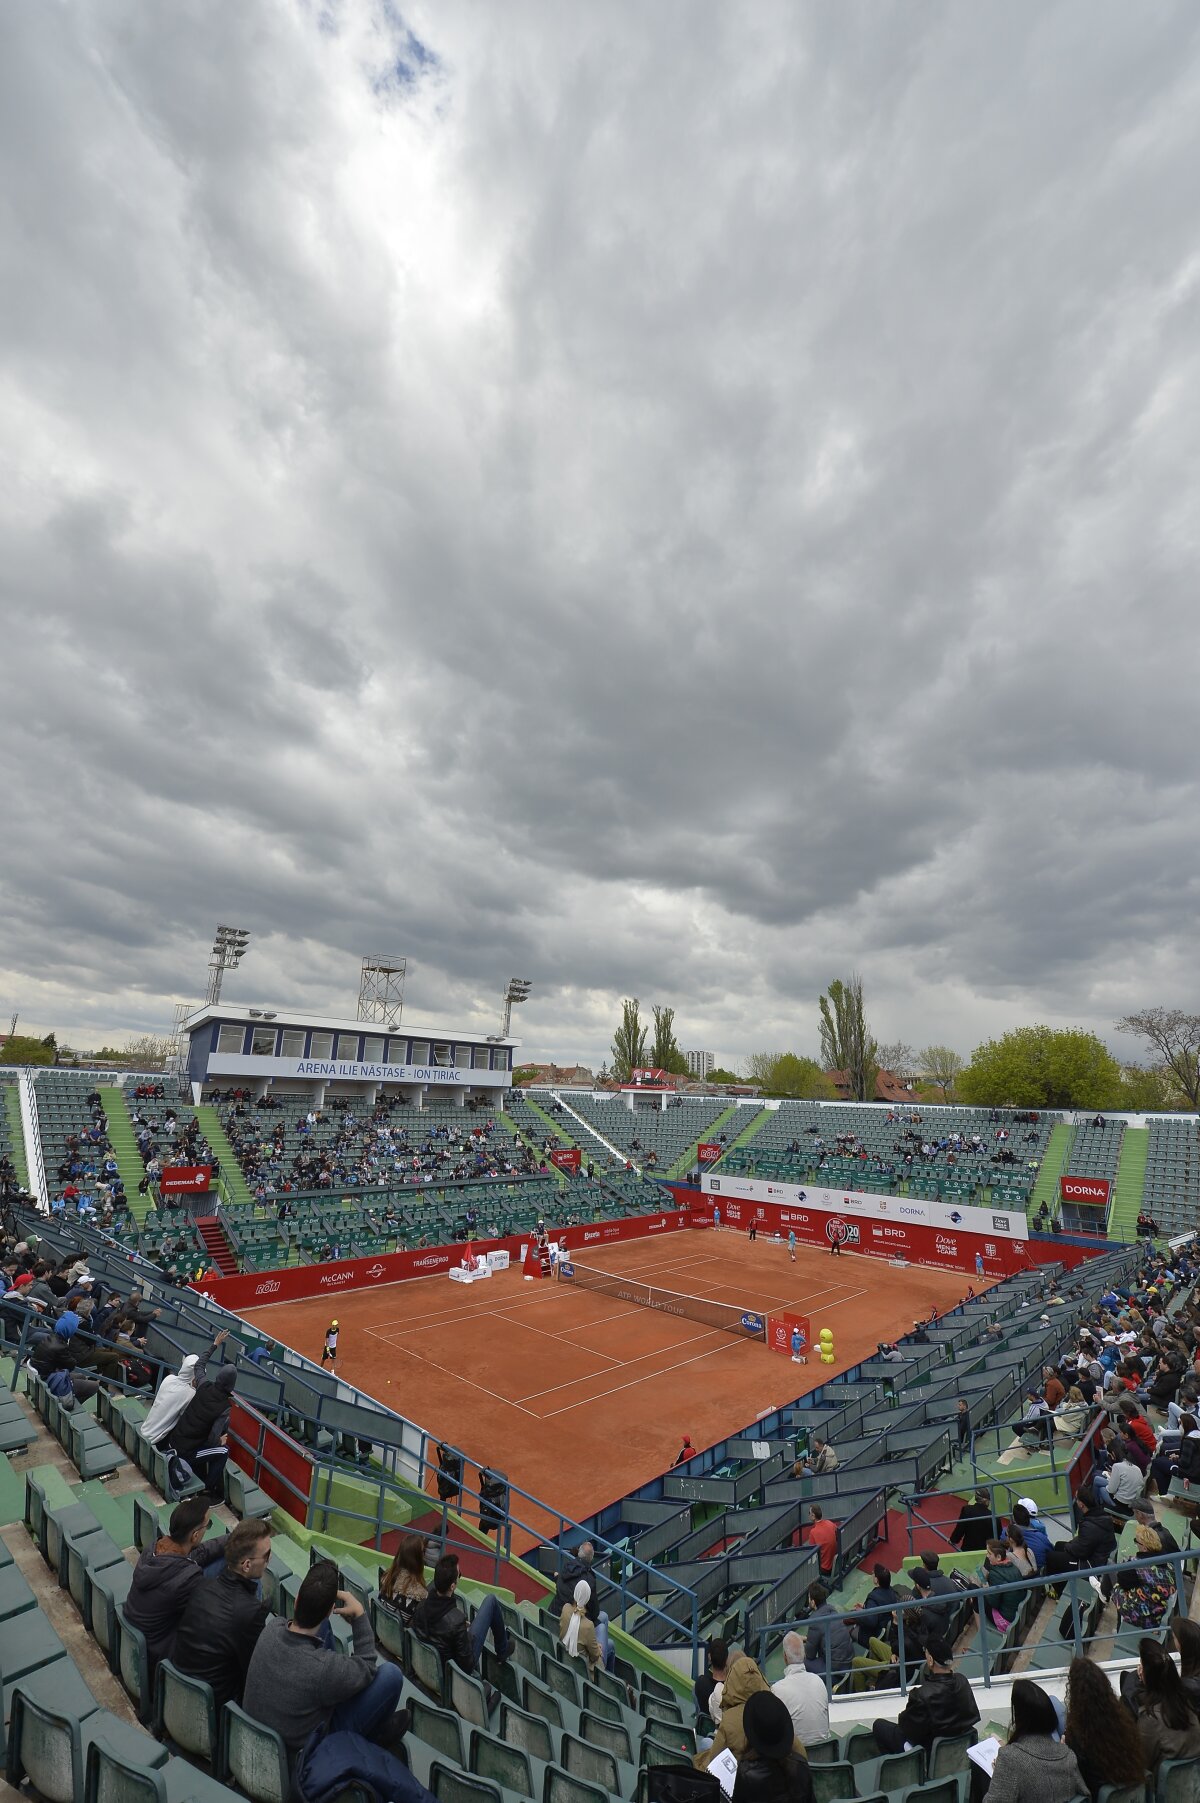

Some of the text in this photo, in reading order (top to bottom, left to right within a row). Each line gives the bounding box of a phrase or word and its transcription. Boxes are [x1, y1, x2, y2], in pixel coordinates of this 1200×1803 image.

[297, 1062, 337, 1075] ARENA
[340, 1065, 358, 1076] ILIE
[361, 1067, 405, 1078] NĂSTASE
[414, 1069, 431, 1079] ION
[1065, 1185, 1106, 1197] DORNA
[790, 1213, 809, 1222] BRD
[848, 1226, 859, 1237] 20
[884, 1228, 906, 1238] BRD
[935, 1234, 957, 1245] Dove
[319, 1272, 354, 1284] McCANN
[617, 1291, 632, 1300] ATP
[741, 1317, 763, 1329] Corona
